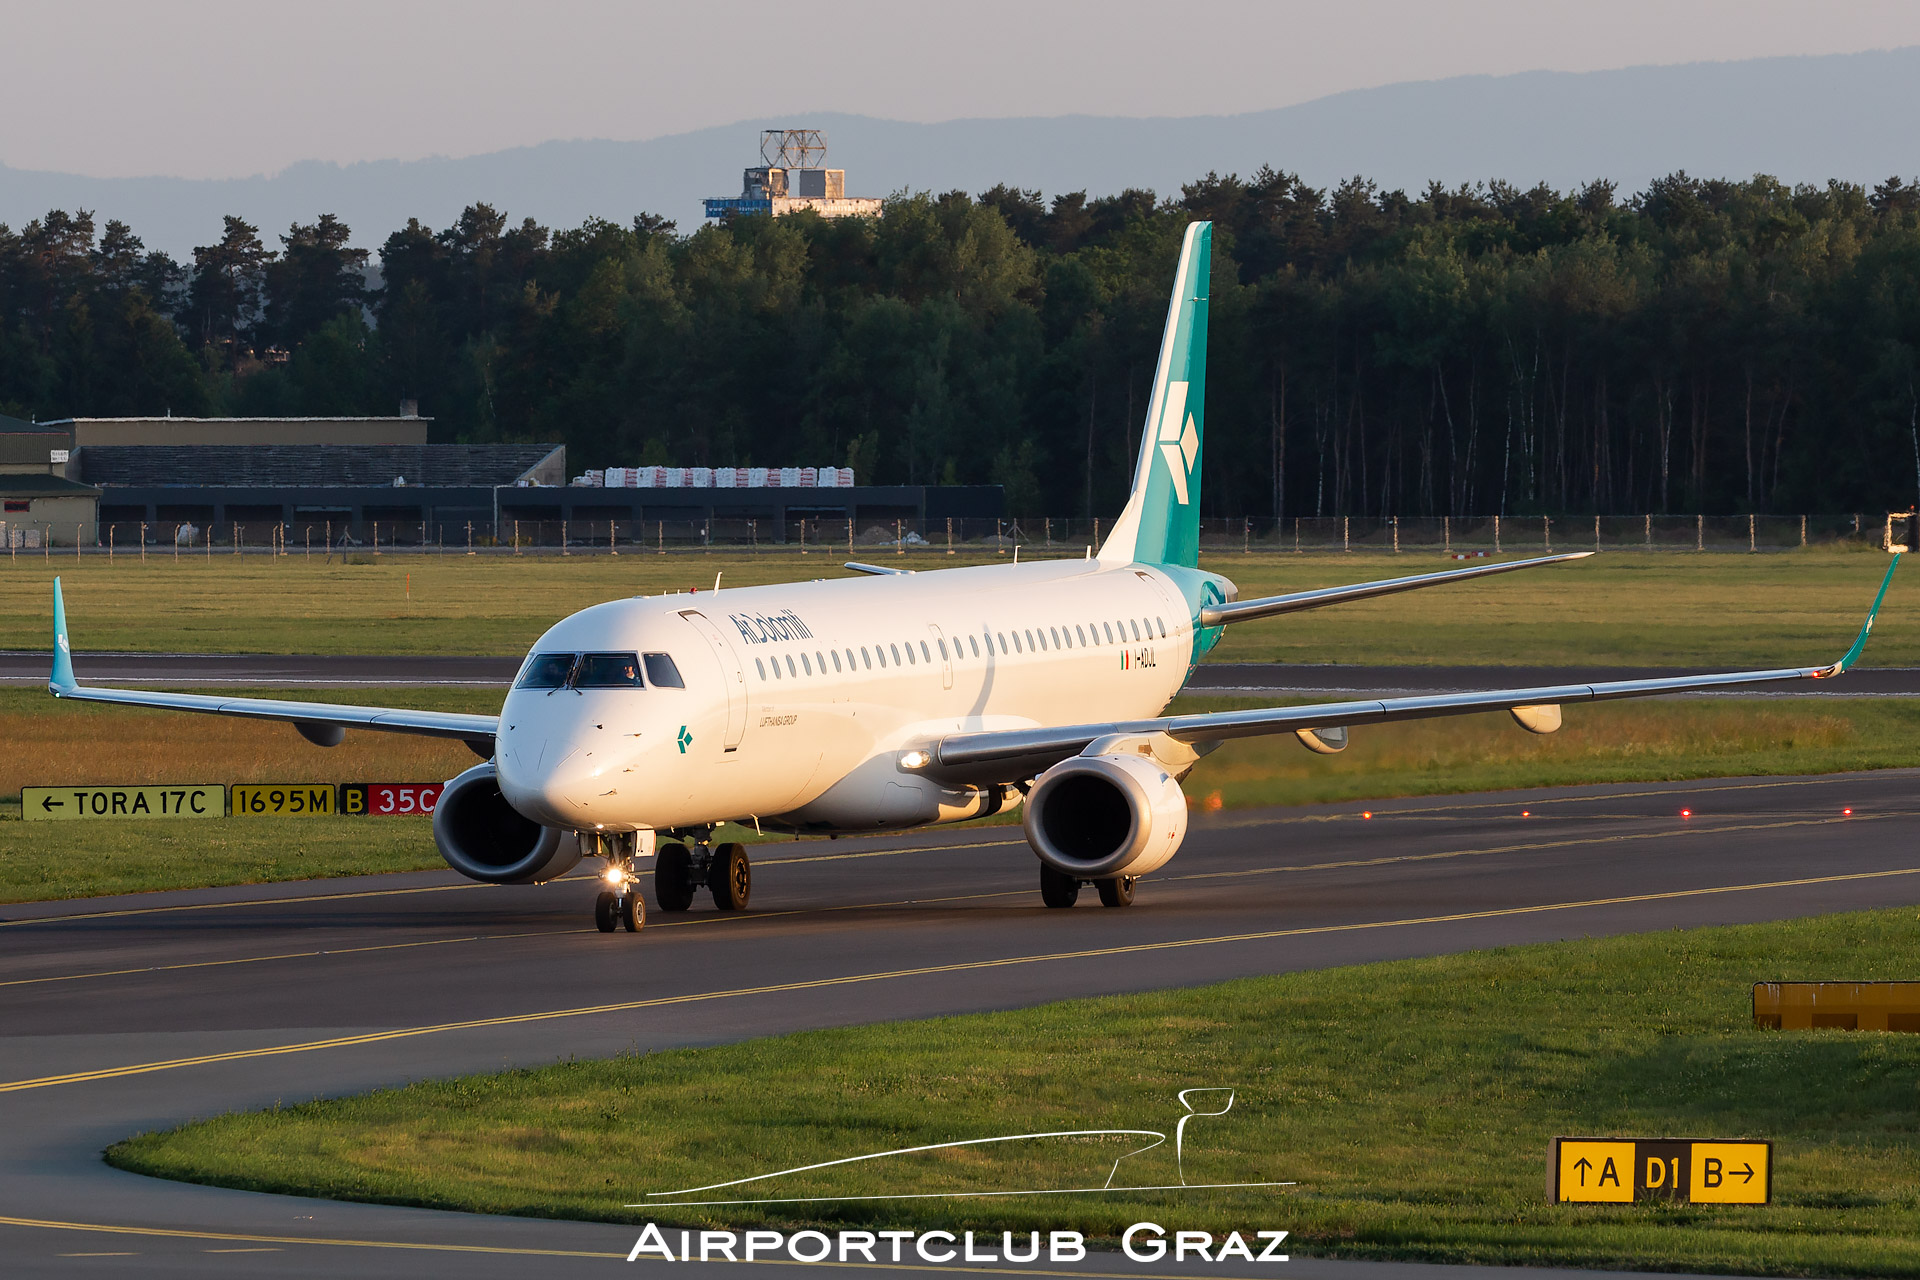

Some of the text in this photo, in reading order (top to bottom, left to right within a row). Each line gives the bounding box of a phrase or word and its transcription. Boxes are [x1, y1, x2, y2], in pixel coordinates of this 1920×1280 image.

[1134, 647, 1156, 669] I-ADJL
[783, 715, 797, 726] GROUP
[74, 790, 206, 815] TORA 17C
[239, 789, 328, 813] 1695M
[346, 789, 363, 813] B
[379, 789, 435, 812] 35C
[1598, 1157, 1620, 1187] A
[1646, 1157, 1679, 1189] D1
[1704, 1158, 1723, 1188] B
